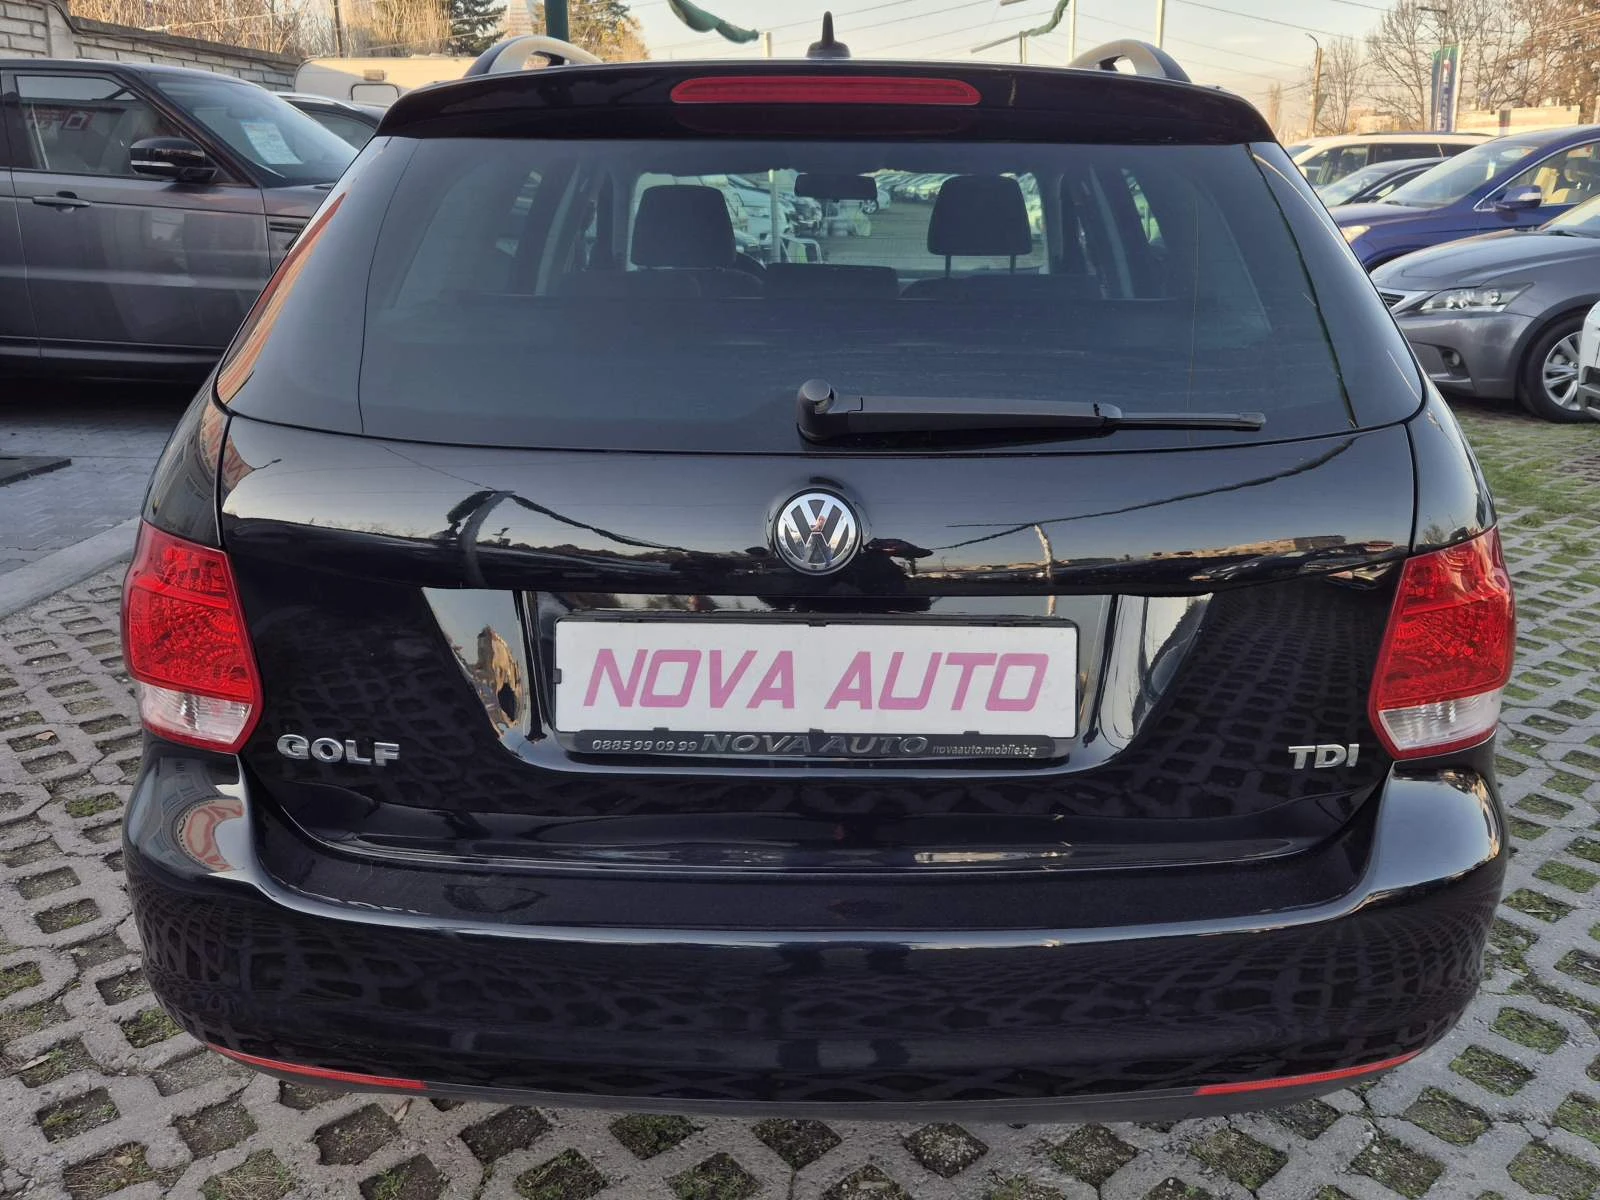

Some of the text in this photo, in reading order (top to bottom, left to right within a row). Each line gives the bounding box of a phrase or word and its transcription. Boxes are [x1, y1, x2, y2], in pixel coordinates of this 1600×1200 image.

[583, 648, 1050, 712] NOVA AUTO
[277, 734, 400, 767] GOLF
[700, 734, 929, 754] NOVA AUTO
[1288, 743, 1360, 769] TDI
